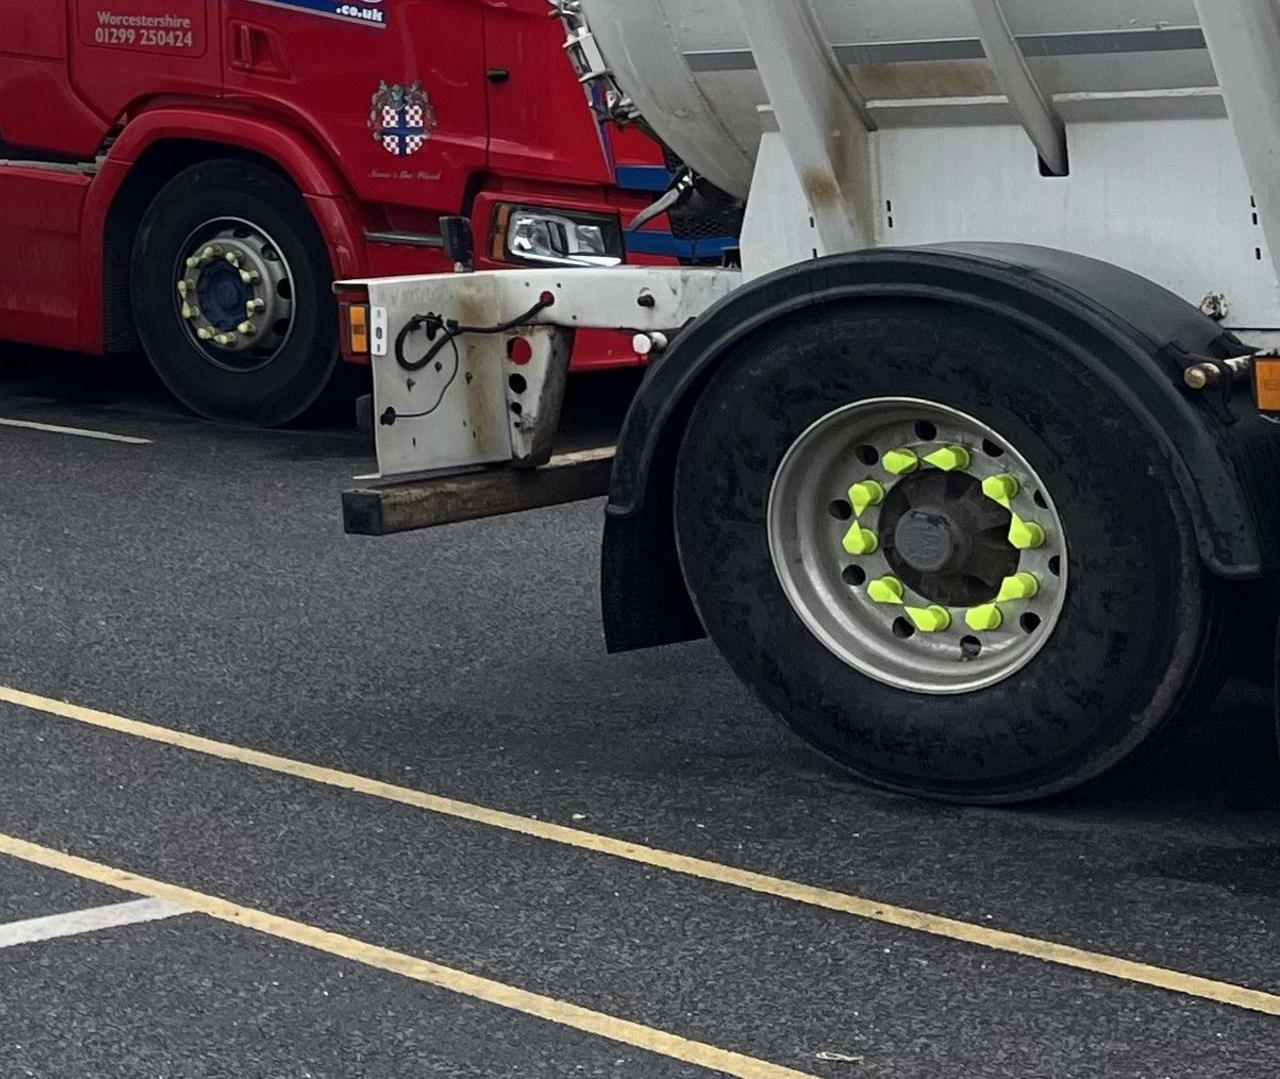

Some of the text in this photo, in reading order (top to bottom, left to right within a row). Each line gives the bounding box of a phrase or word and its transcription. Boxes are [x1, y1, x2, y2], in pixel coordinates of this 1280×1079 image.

[96, 11, 192, 28] Worcestershire
[335, 5, 383, 22] .co.uk
[95, 27, 193, 47] 01299 250424
